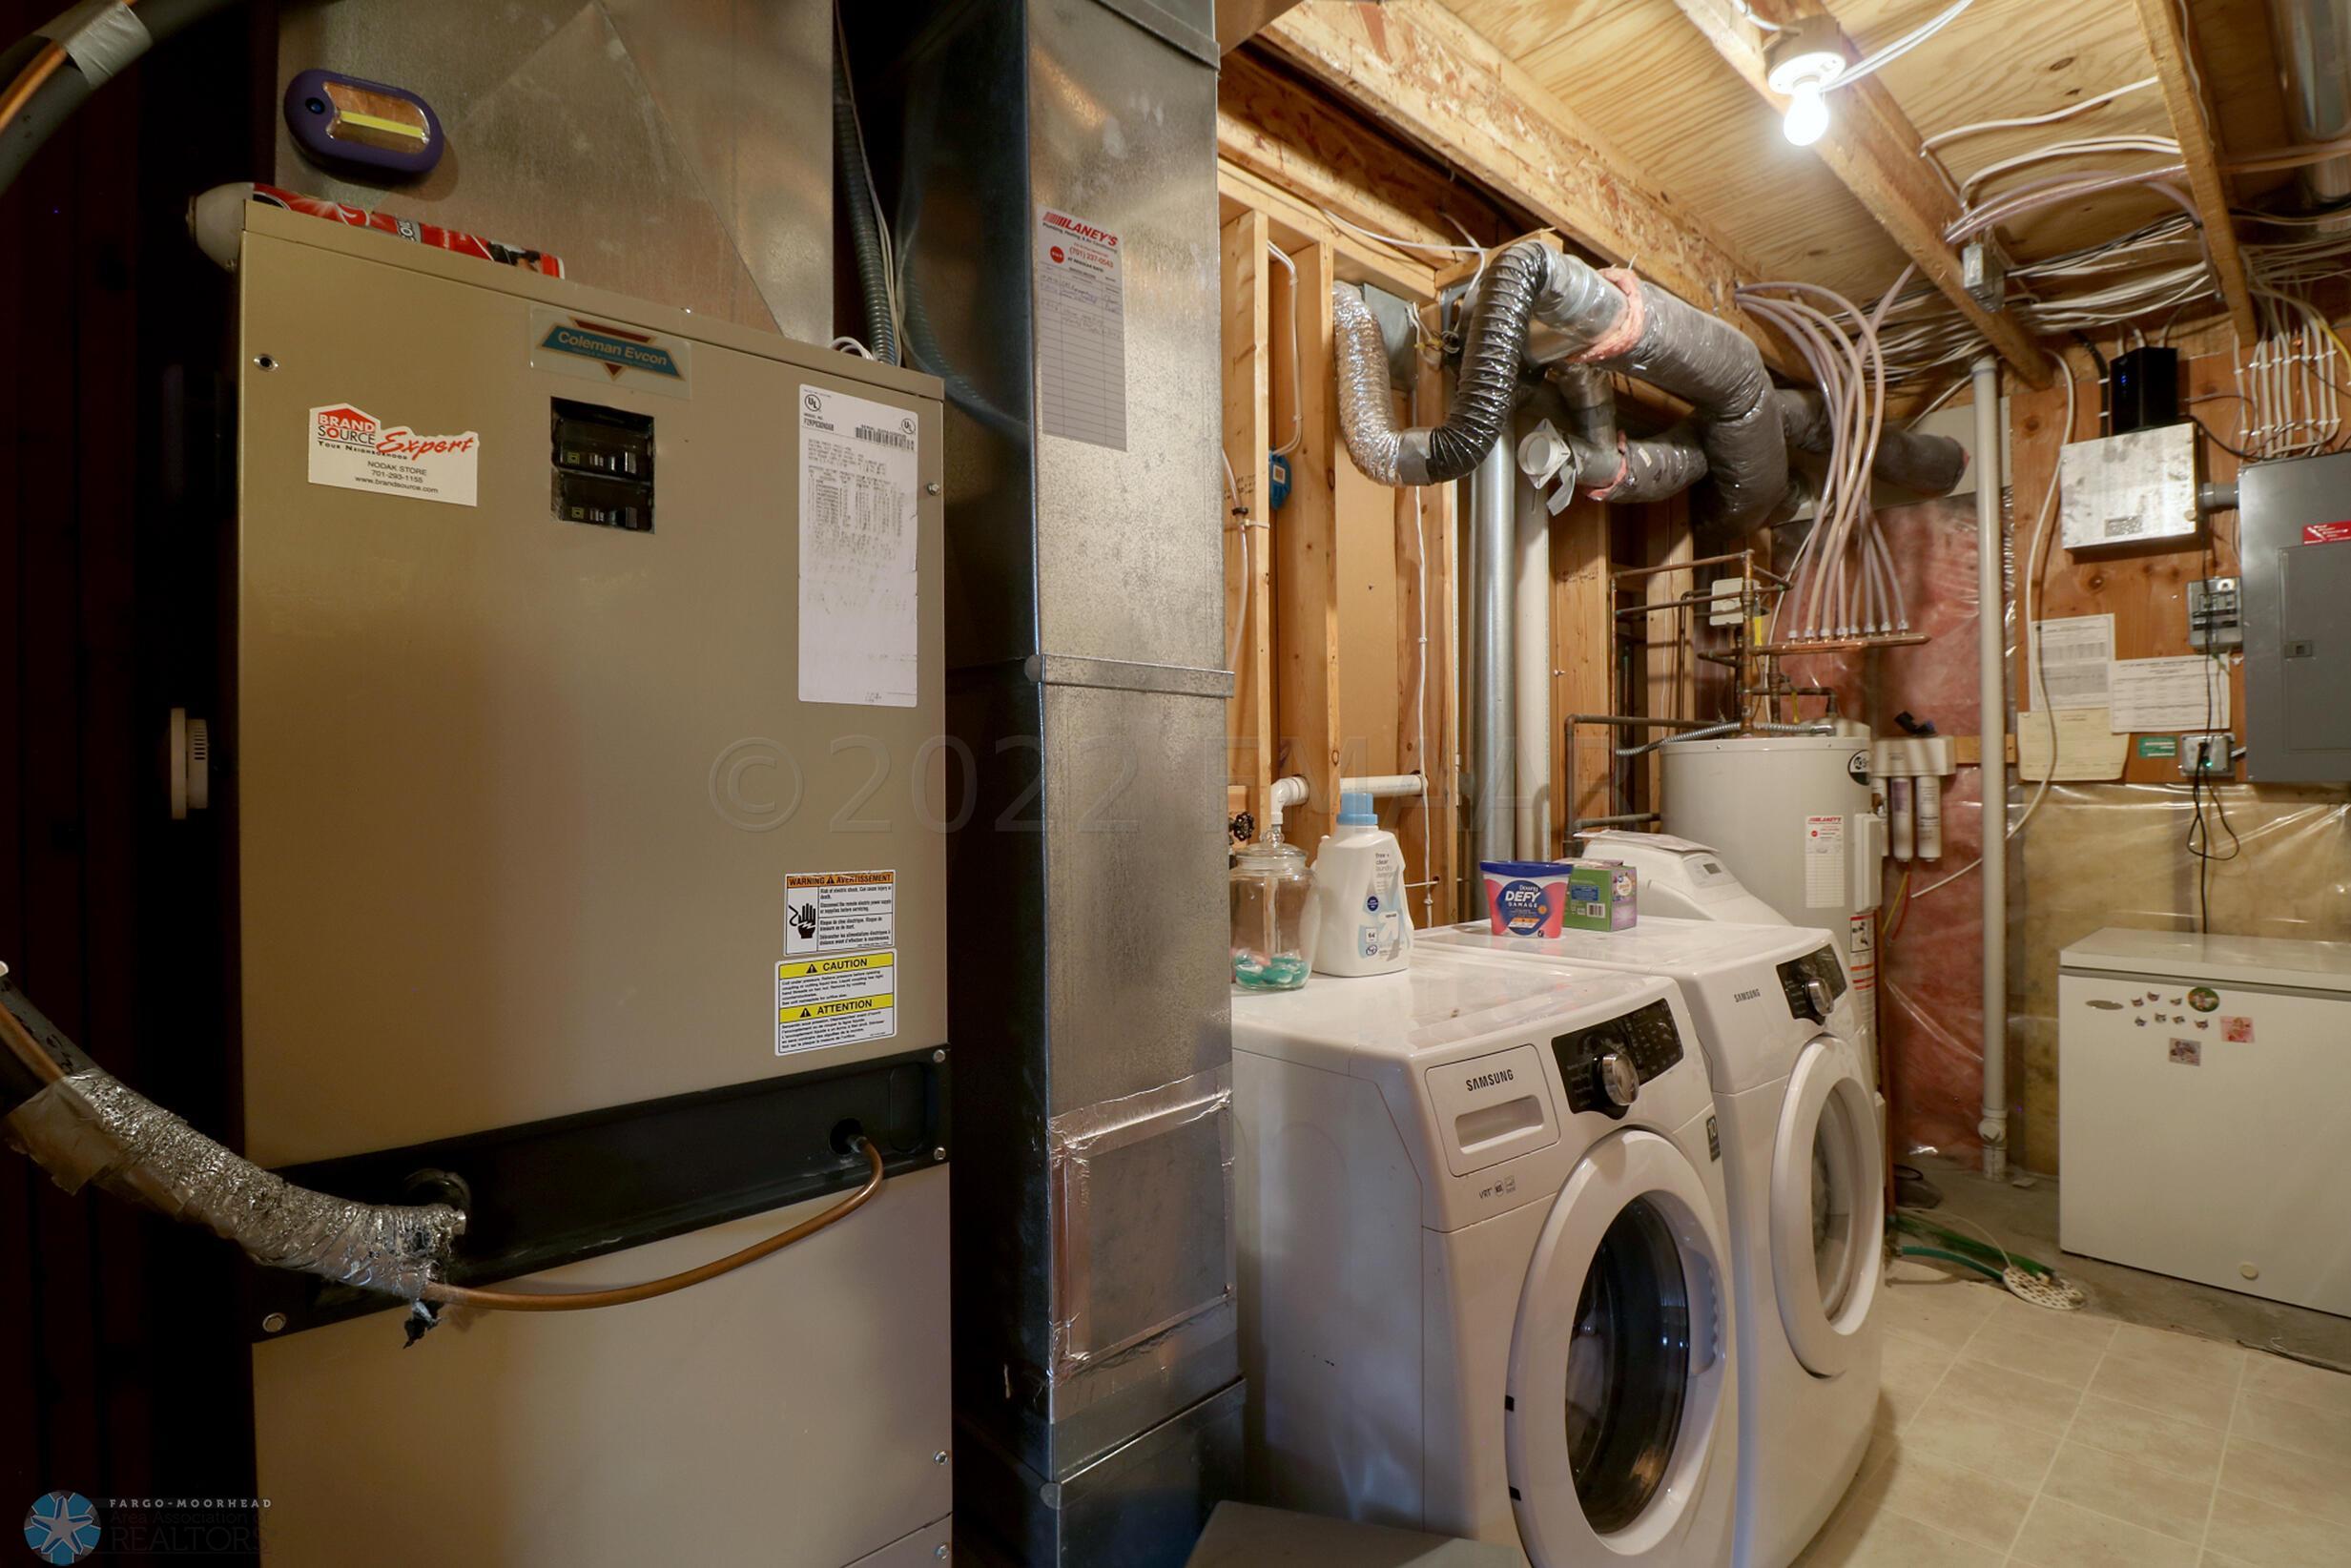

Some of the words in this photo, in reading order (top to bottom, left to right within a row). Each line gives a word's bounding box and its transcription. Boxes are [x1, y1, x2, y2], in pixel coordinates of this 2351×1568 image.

[1065, 219, 1118, 246] LANEY'S
[558, 331, 621, 356] Coleman
[624, 347, 667, 366] Evcon
[319, 413, 376, 433] BRAND
[318, 425, 375, 445] SOURCE
[376, 431, 475, 461] Expert
[367, 461, 397, 472] NODAK
[400, 465, 426, 476] STORE
[355, 477, 439, 494] www.brandsource.com
[789, 877, 825, 886] WARNING
[836, 874, 891, 884] AVERTISSEMENT
[1505, 891, 1540, 902] DEFY
[823, 959, 867, 972] CAUTION
[1734, 988, 1761, 1002] SAMSUNG
[817, 1000, 873, 1015] ATTENTION
[1466, 1069, 1514, 1091] SAMSUNG
